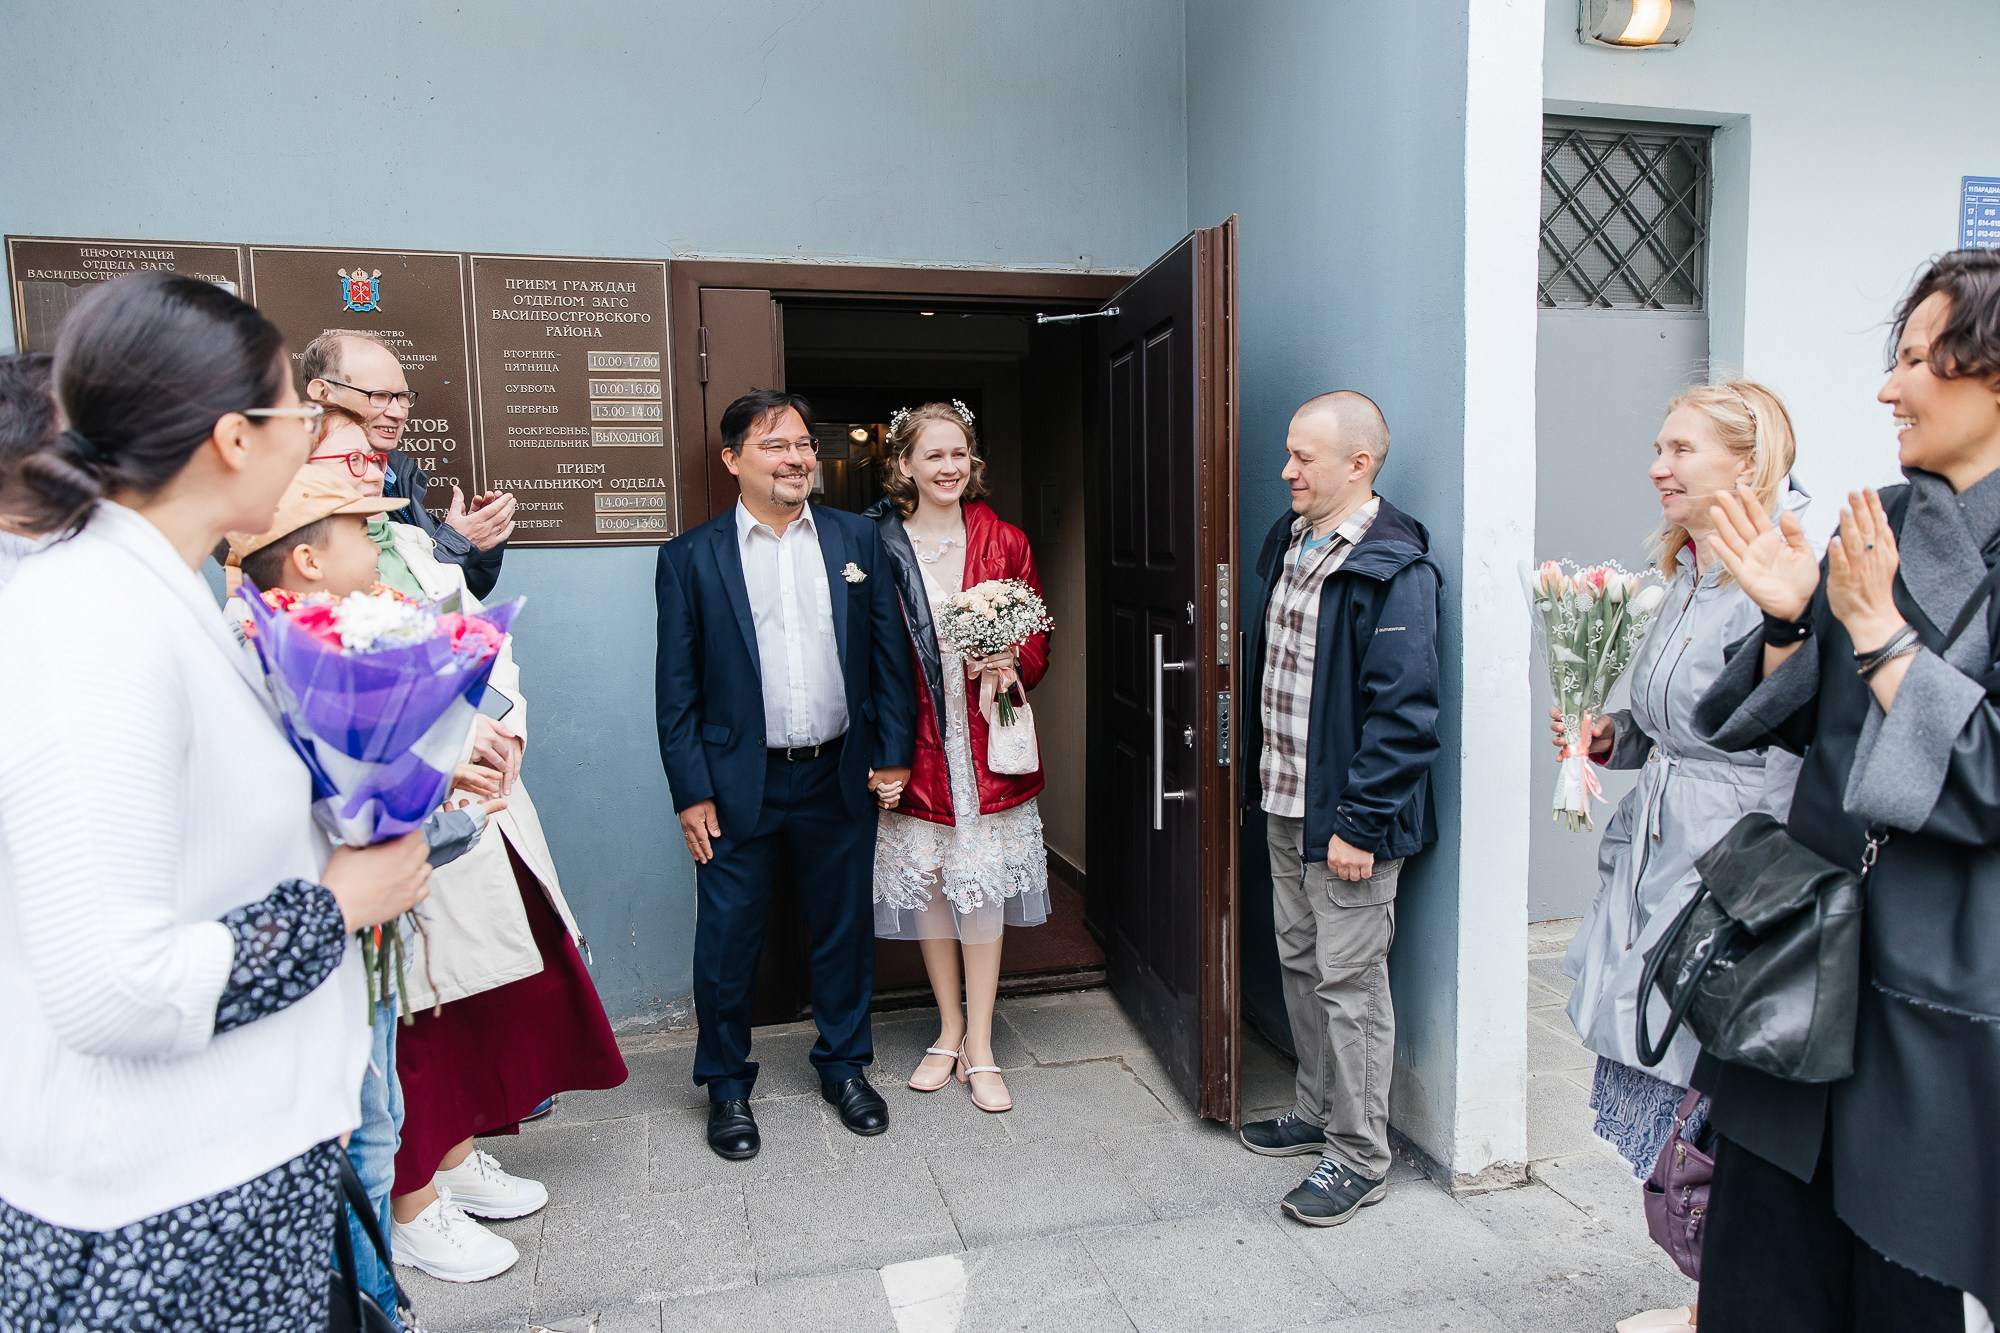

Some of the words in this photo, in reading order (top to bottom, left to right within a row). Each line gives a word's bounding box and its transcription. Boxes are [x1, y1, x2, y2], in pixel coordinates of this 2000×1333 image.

[80, 248, 175, 260] ИНФОРМАЦИЯ
[83, 260, 136, 271] ОТДЕЛА
[140, 261, 175, 272] ЗАГС
[27, 269, 129, 281] ВАСИЛЕОСТРО
[194, 273, 227, 282] ЙОНА
[505, 278, 557, 291] ПРИЕМ
[563, 280, 637, 293] ГРАЖДАН
[513, 295, 585, 307] ОТДЕЛОМ
[592, 297, 629, 308] ЗАГС
[492, 309, 651, 323] ВАСИЛЕОСТРОВСКОГО
[545, 324, 603, 338] РАЙОНА
[400, 354, 438, 362] ЗАПИСИ
[592, 356, 658, 368] 10.00-17.00
[504, 363, 560, 373] ПЯТНИЦА
[505, 384, 556, 393] СУББОТА
[594, 383, 659, 394] 10.00-16.00
[506, 405, 559, 414] ПЕРЕРЫВ
[595, 406, 661, 417] 13.00-14.00
[508, 427, 590, 436] ВОСКРЕСЕНЬЕ,
[595, 431, 660, 444] ВЫХОДНОЙ
[508, 439, 590, 449] ПОНЕДЕЛЬНИК
[557, 463, 606, 474] ПРИЕМ
[494, 479, 603, 490] НАЧАЛЬНИКОМ
[610, 478, 666, 490] ОТДЕЛА
[599, 497, 664, 508] 14.00-17.00
[600, 518, 664, 529] 10.00-13.00
